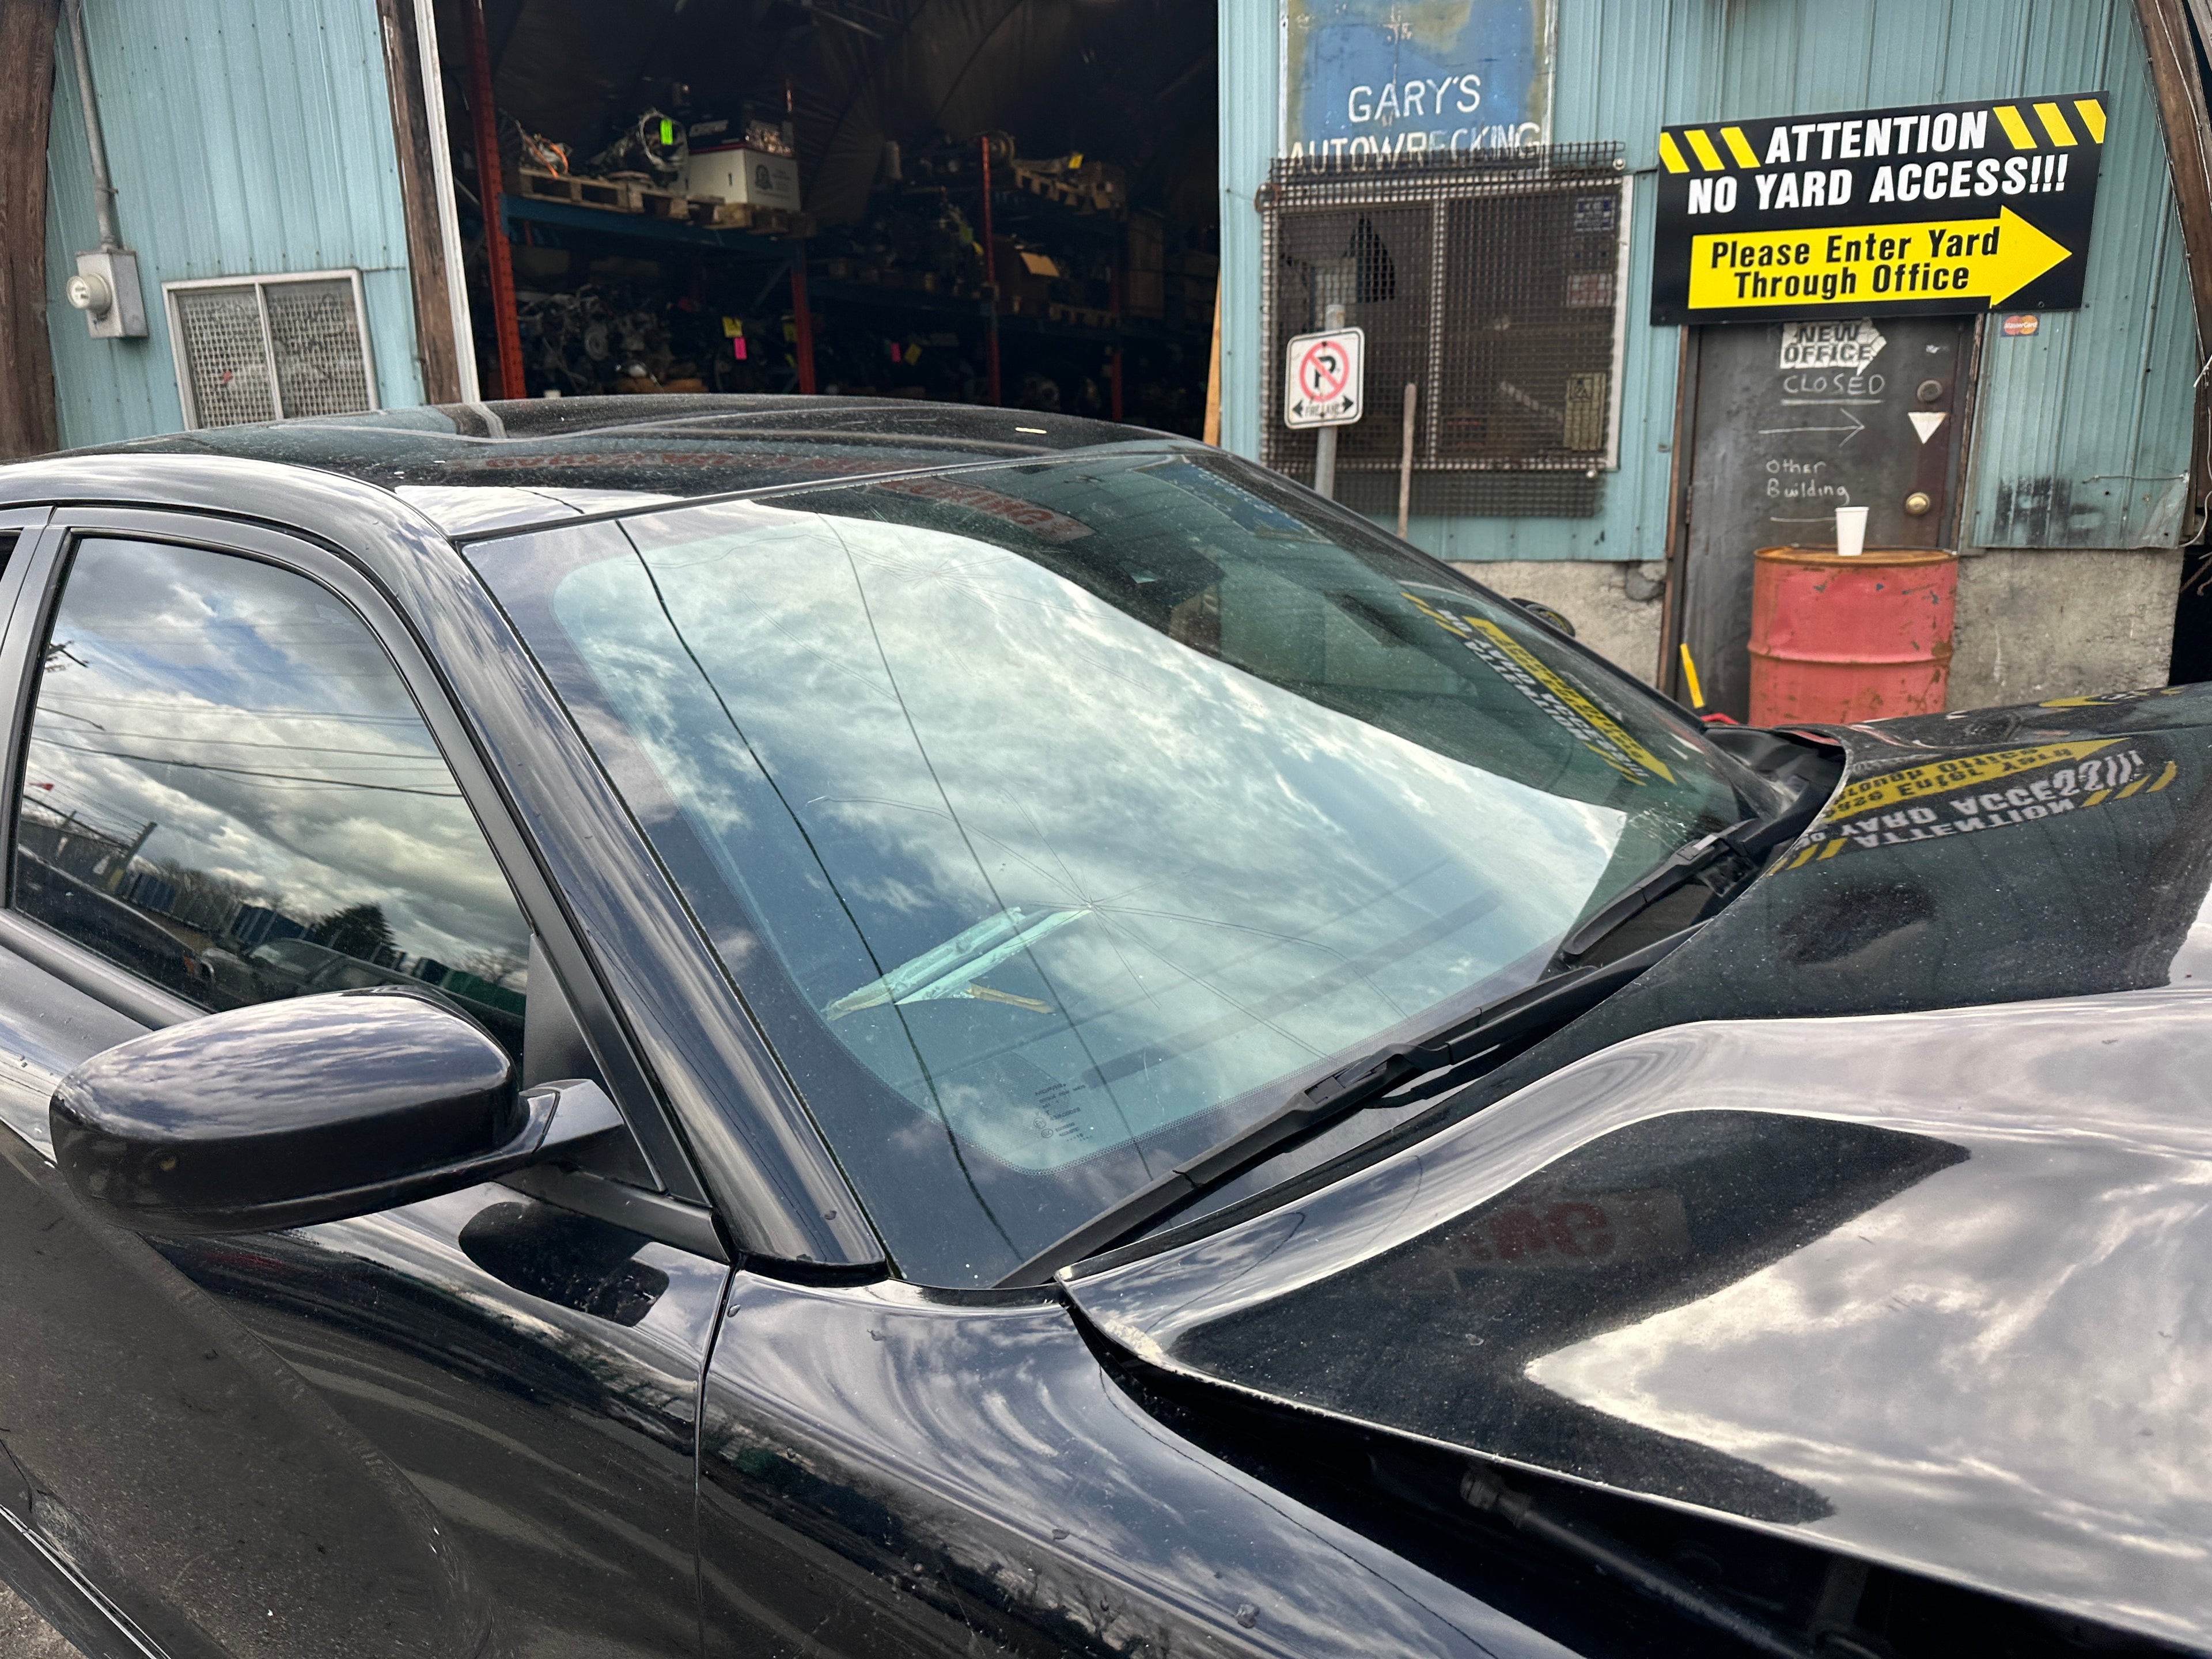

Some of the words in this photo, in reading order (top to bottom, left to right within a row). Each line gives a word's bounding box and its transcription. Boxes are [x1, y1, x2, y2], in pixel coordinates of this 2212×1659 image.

[1348, 74, 1481, 123] GARY'S
[1765, 111, 1988, 164] ATTENTION
[1687, 176, 1737, 214] NO
[1756, 169, 1852, 210] YARD
[1869, 154, 2068, 203] ACCESS!!!
[1711, 240, 1810, 268] Please
[1826, 233, 1911, 262] Enter
[1928, 226, 2000, 257] Yard
[1734, 270, 1858, 300] Through
[1872, 264, 1969, 293] Office
[1800, 324, 1858, 342] NEW
[1784, 344, 1872, 363] OFFICE
[1783, 373, 1885, 395] CLOSED
[1766, 459, 1827, 474] Other
[1767, 478, 1850, 506] Building
